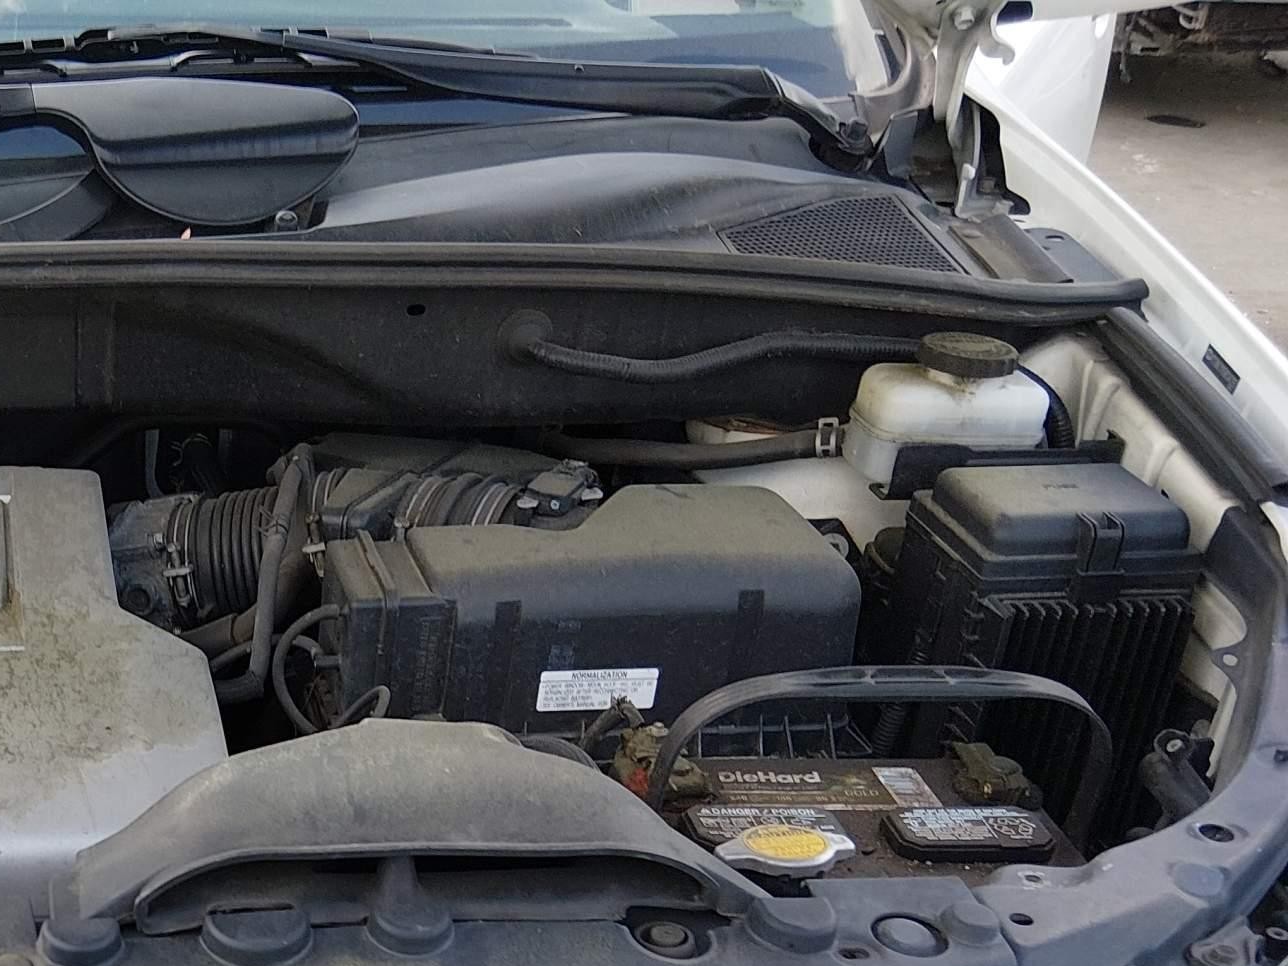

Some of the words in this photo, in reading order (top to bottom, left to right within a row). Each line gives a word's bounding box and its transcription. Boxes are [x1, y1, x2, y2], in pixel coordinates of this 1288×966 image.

[572, 671, 628, 680] NORMALIZATION
[718, 771, 822, 785] DieHard
[712, 808, 760, 816] DANGER
